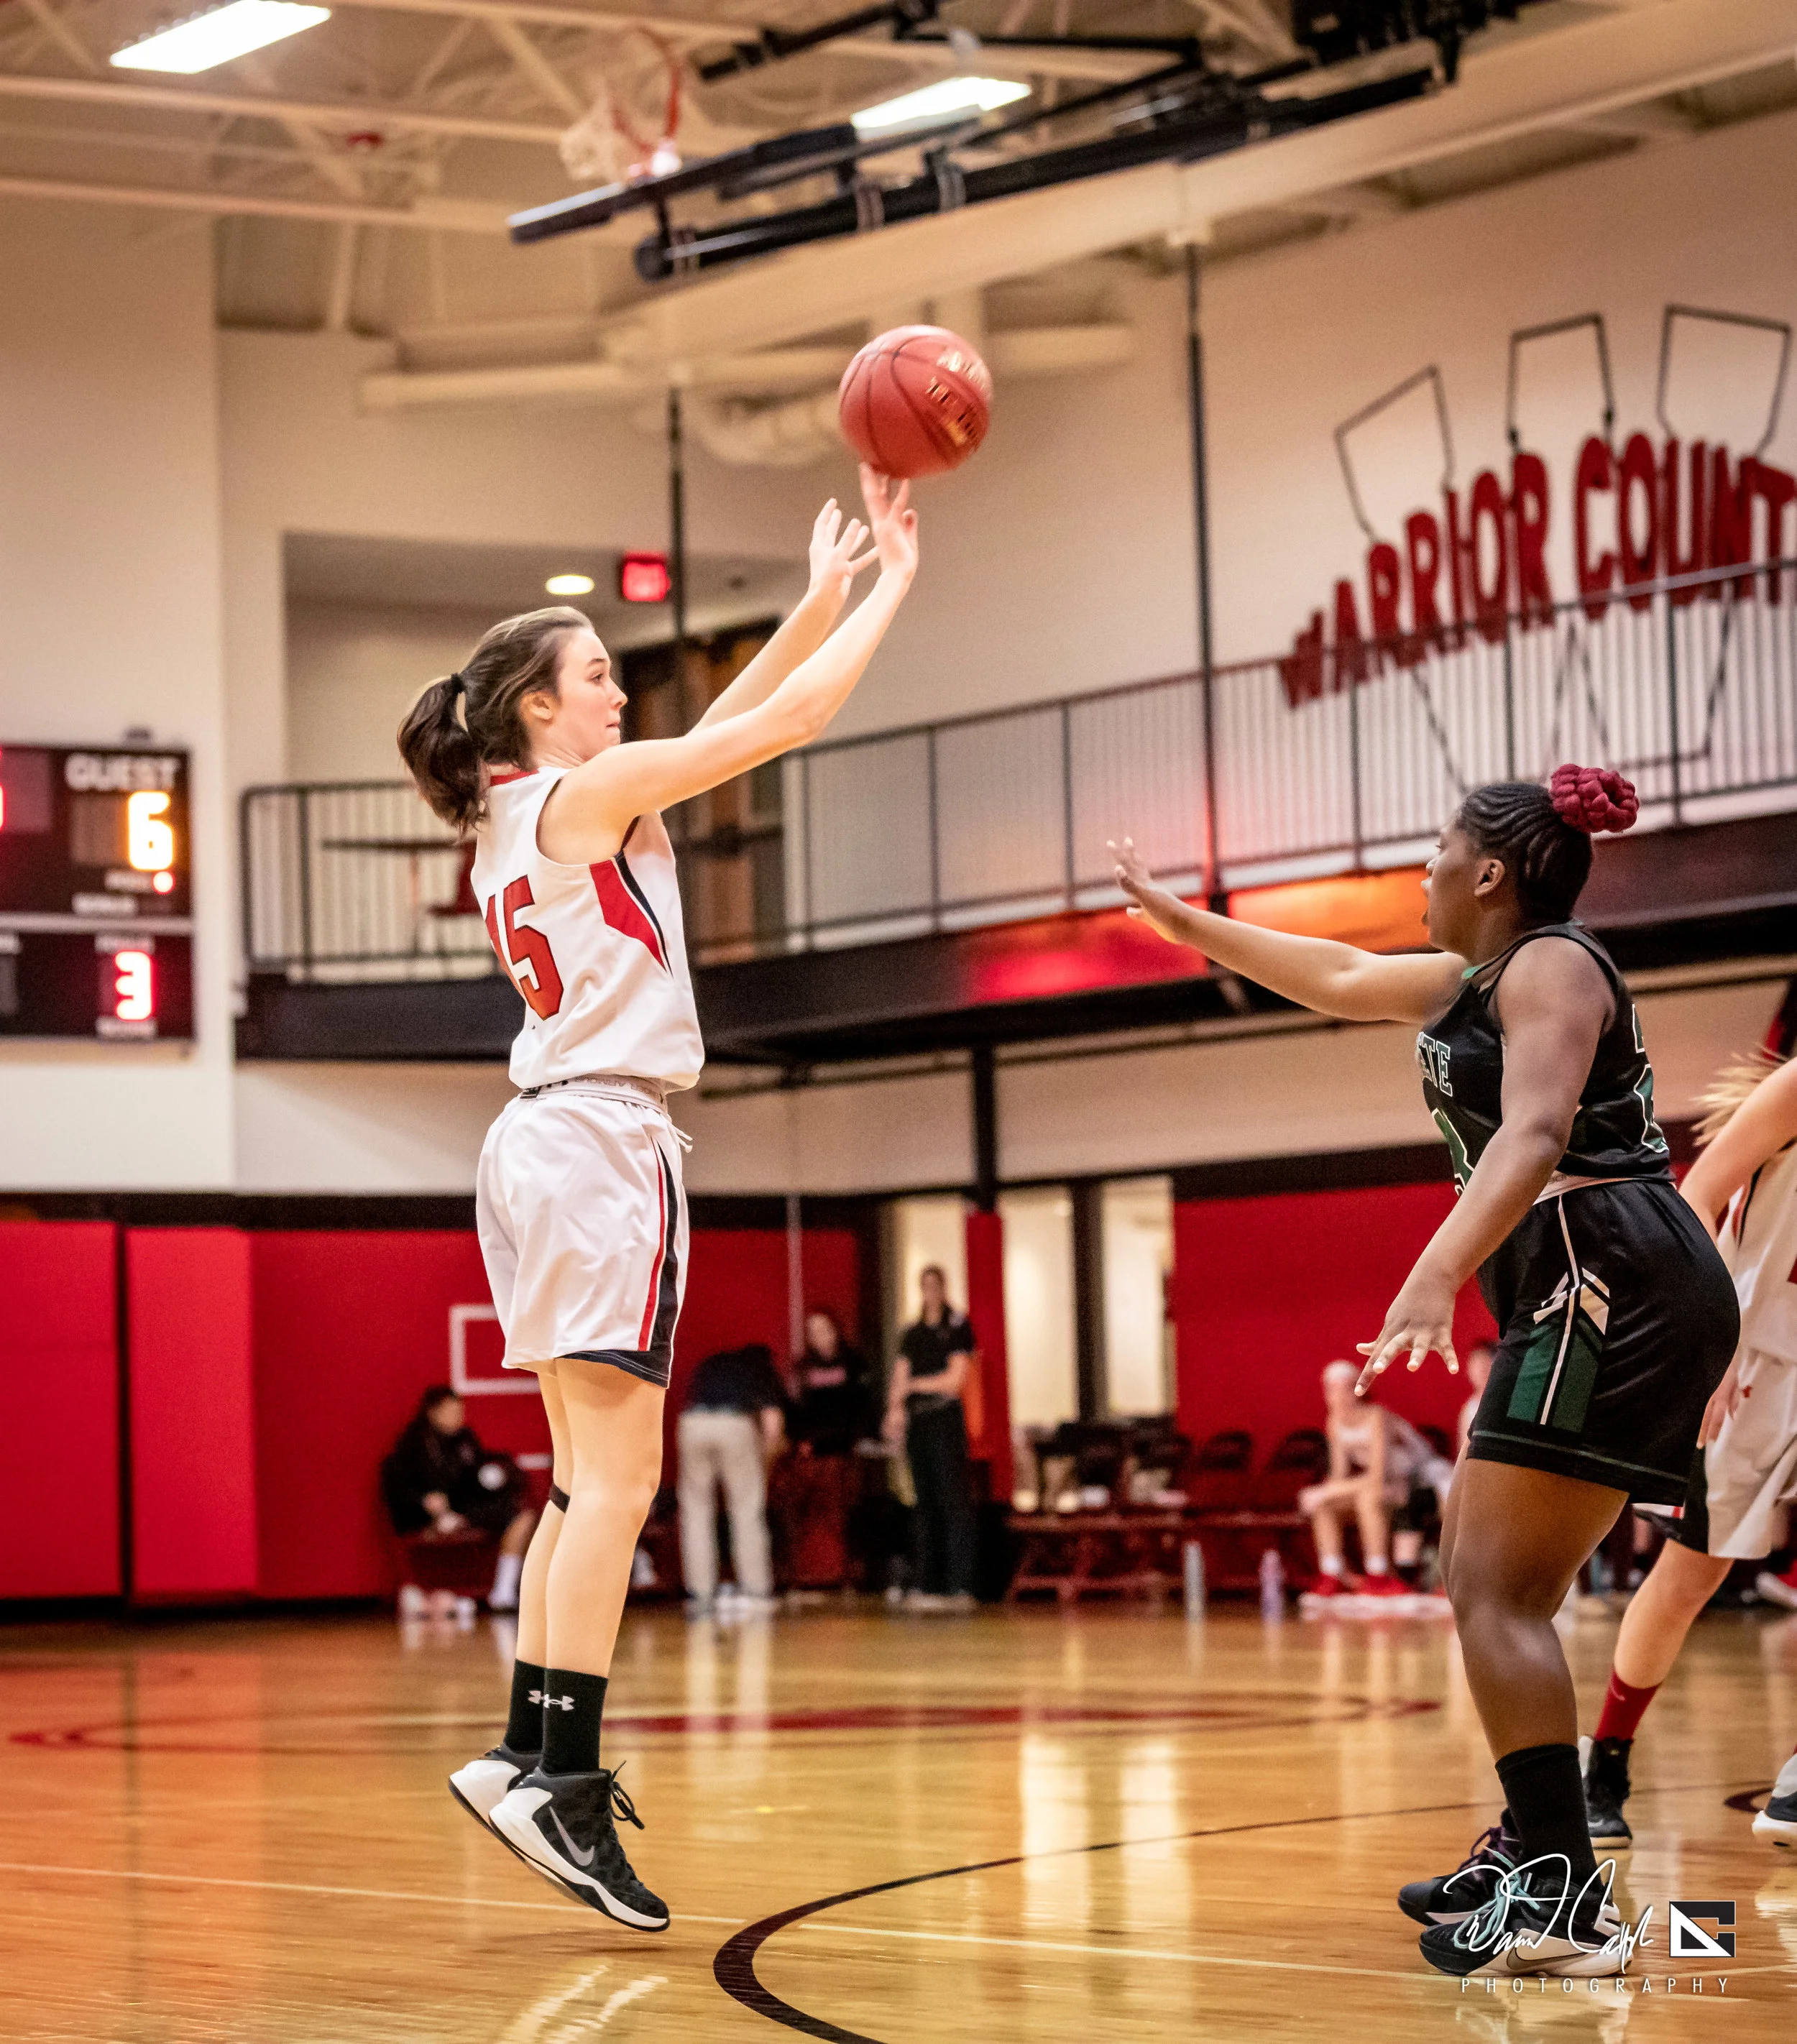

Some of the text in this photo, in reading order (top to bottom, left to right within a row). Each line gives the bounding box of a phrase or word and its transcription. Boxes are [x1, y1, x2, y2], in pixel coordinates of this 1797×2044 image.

[1277, 453, 1555, 710] WARRIOR
[65, 753, 179, 791] GUEST
[128, 791, 173, 871] 6
[114, 950, 153, 1021] 3
